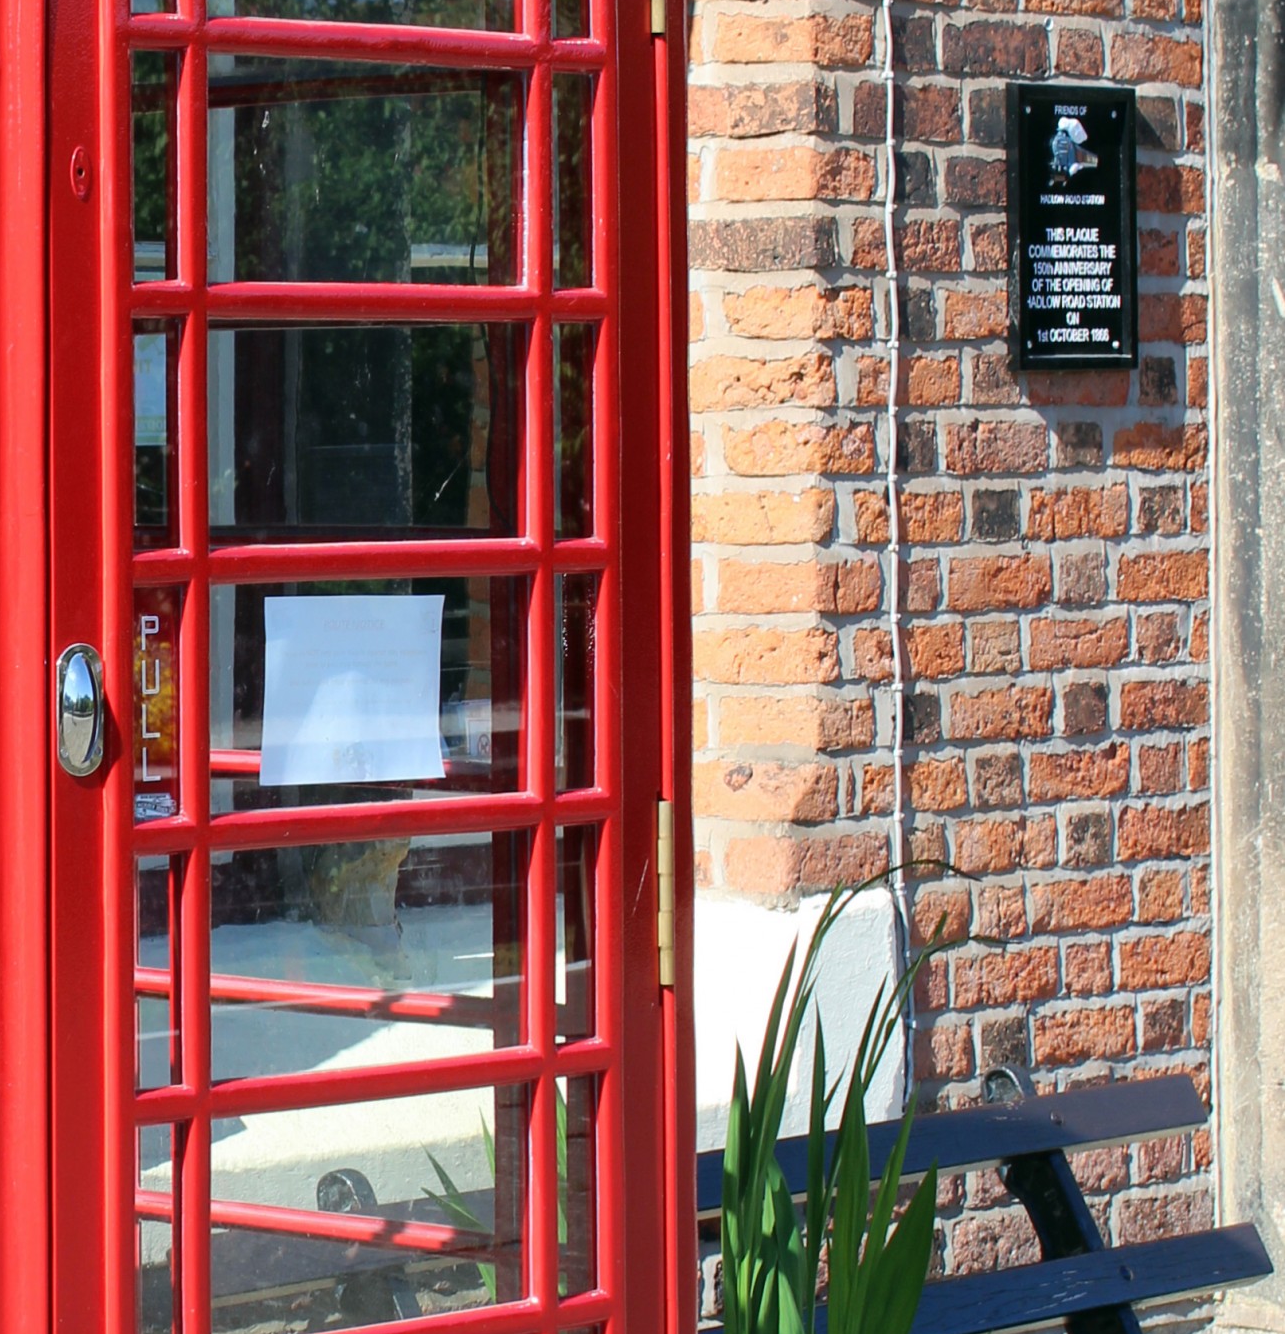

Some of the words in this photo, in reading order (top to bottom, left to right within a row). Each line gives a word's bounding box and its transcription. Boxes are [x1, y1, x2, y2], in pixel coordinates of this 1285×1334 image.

[1079, 105, 1087, 115] OF
[1046, 228, 1065, 242] THIS
[1066, 228, 1099, 242] PLAQUE
[1028, 245, 1099, 258] COMMEMORATES
[1099, 245, 1116, 258] THE
[1034, 261, 1054, 275] 150th
[1054, 261, 1112, 275] ANNIVERSARY
[1032, 278, 1044, 292] OF
[1045, 278, 1062, 292] THE
[1062, 278, 1100, 292] OPENING
[1101, 278, 1114, 292] OF
[1062, 295, 1086, 309] ROAD
[1086, 295, 1121, 309] STATION
[1066, 312, 1080, 326] ON
[1037, 328, 1049, 342] 1st
[1050, 328, 1090, 342] OCTOBER
[140, 615, 161, 782] PULL
